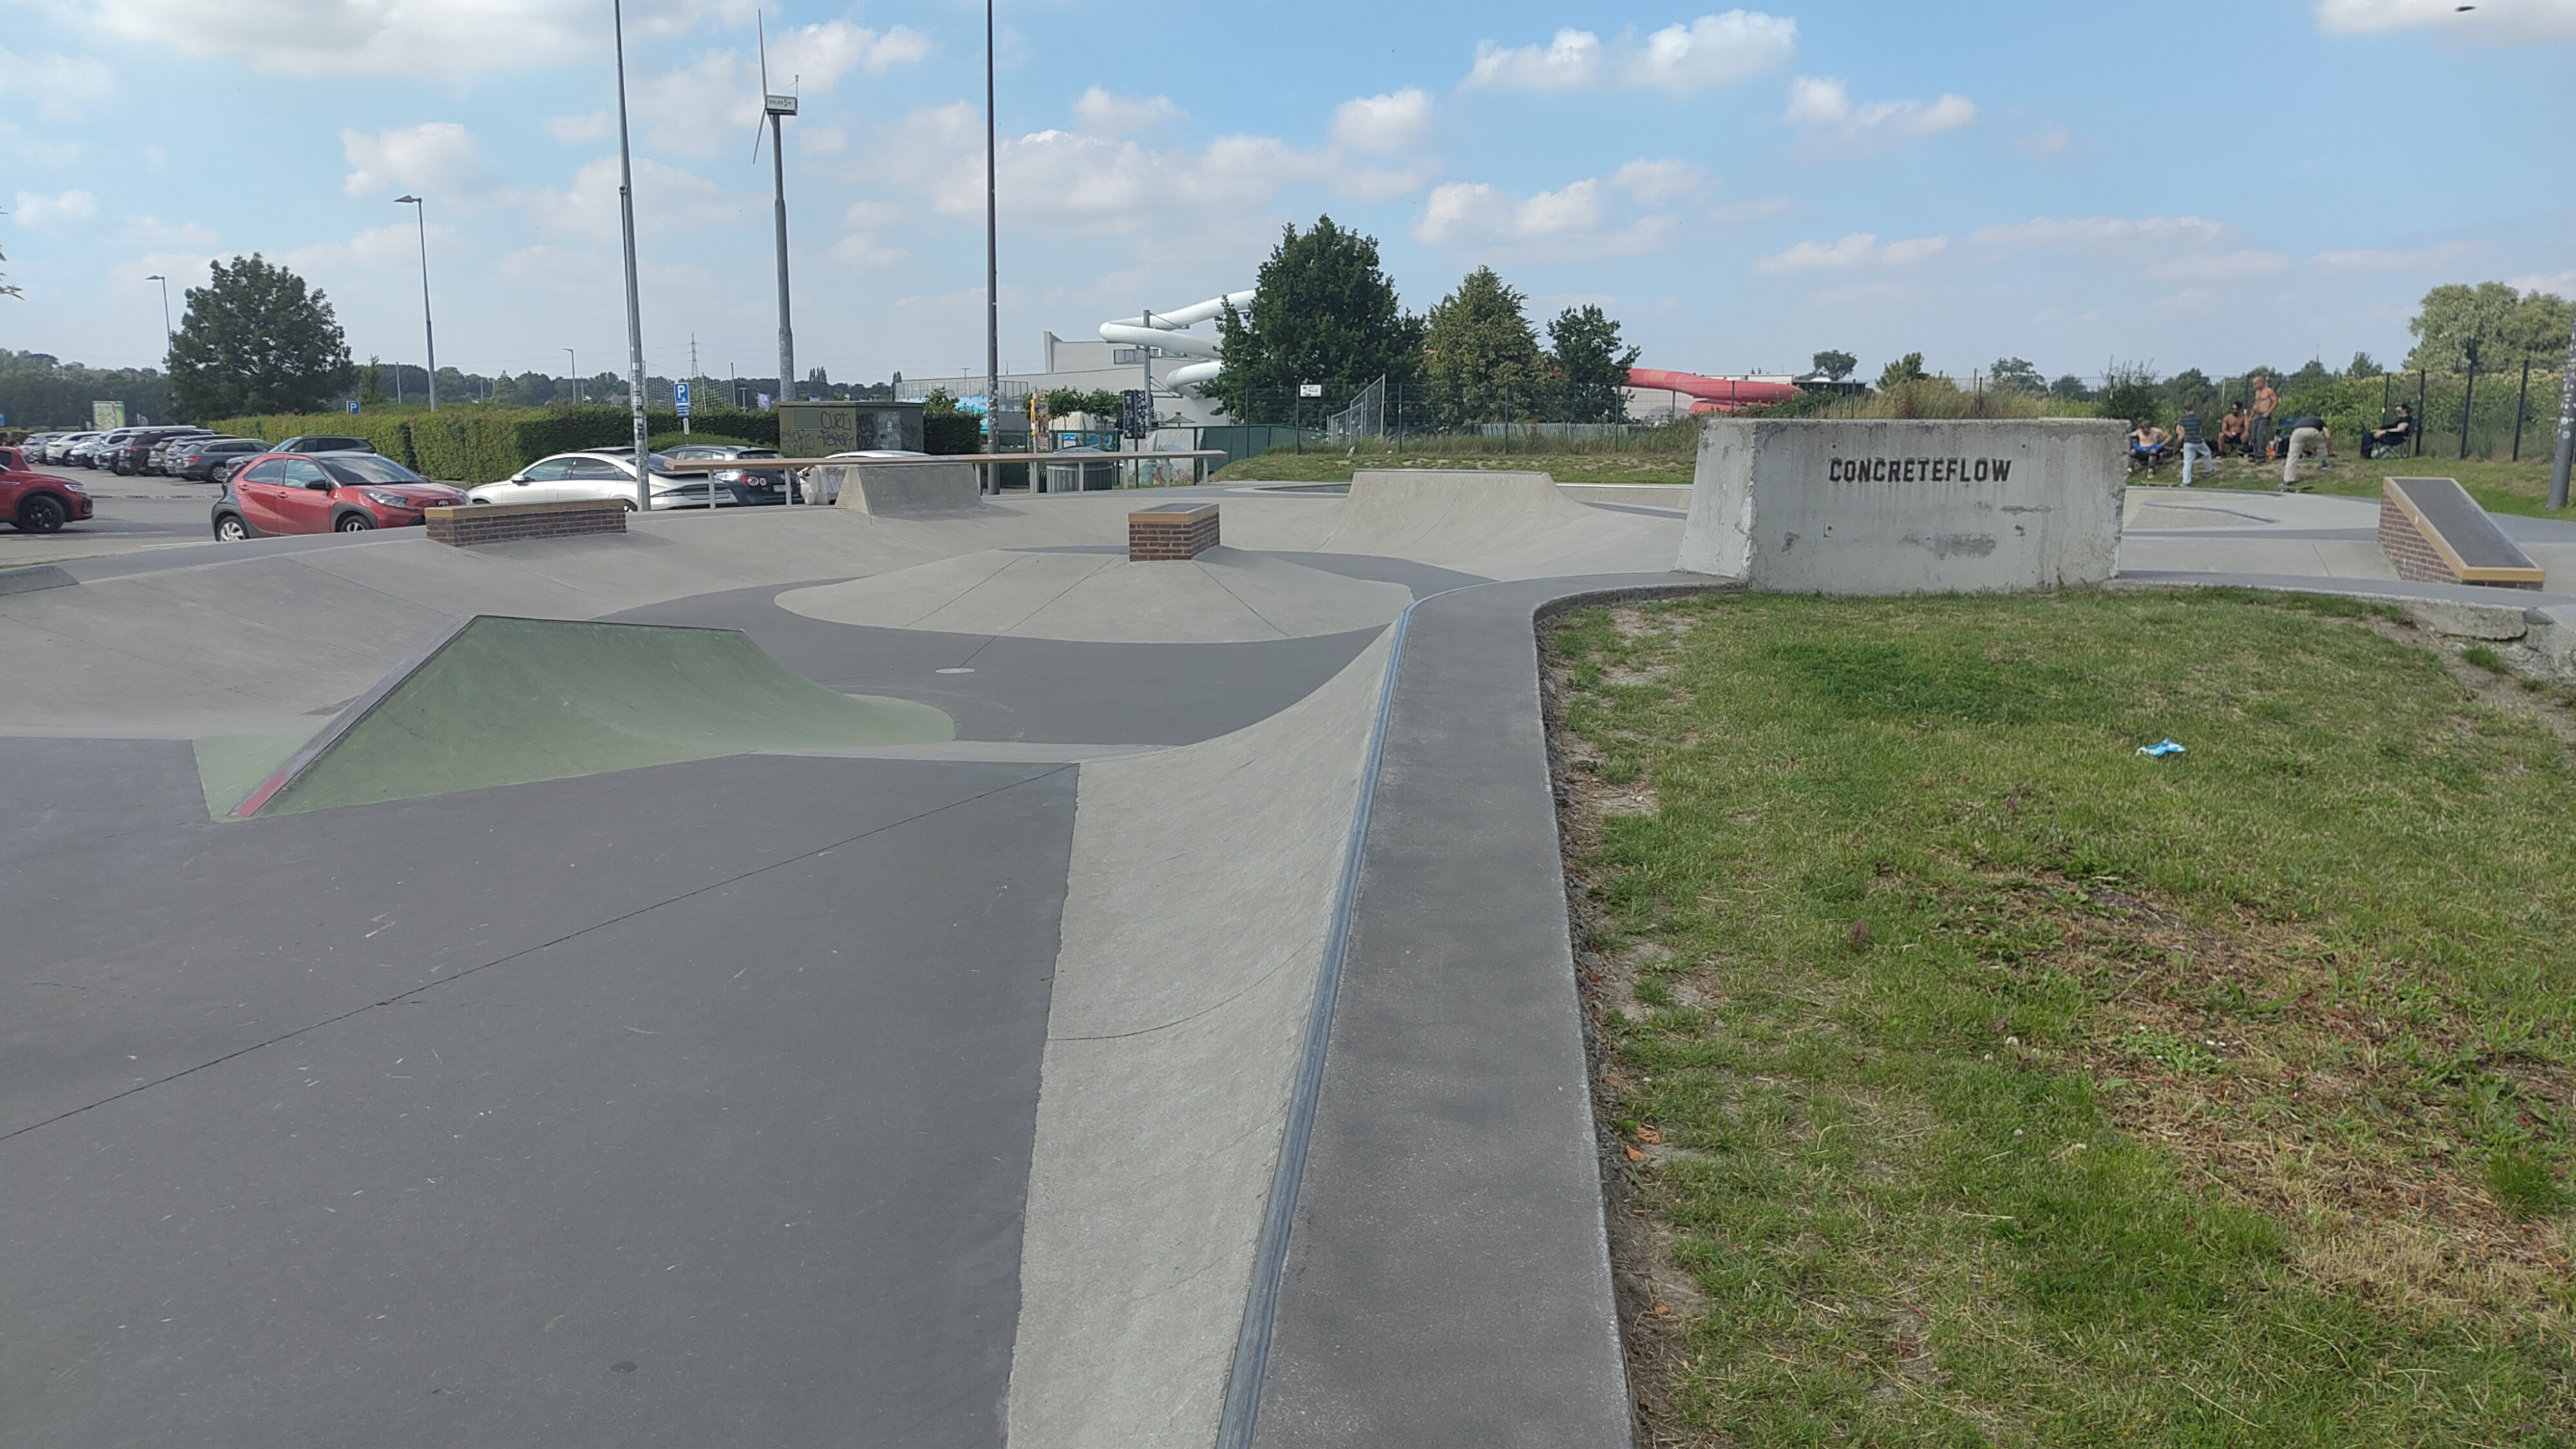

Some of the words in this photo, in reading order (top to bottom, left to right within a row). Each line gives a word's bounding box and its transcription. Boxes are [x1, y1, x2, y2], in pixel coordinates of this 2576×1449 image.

[677, 385, 685, 399] P
[350, 402, 357, 413] P
[1829, 459, 2011, 482] CONCRETEFLOW
